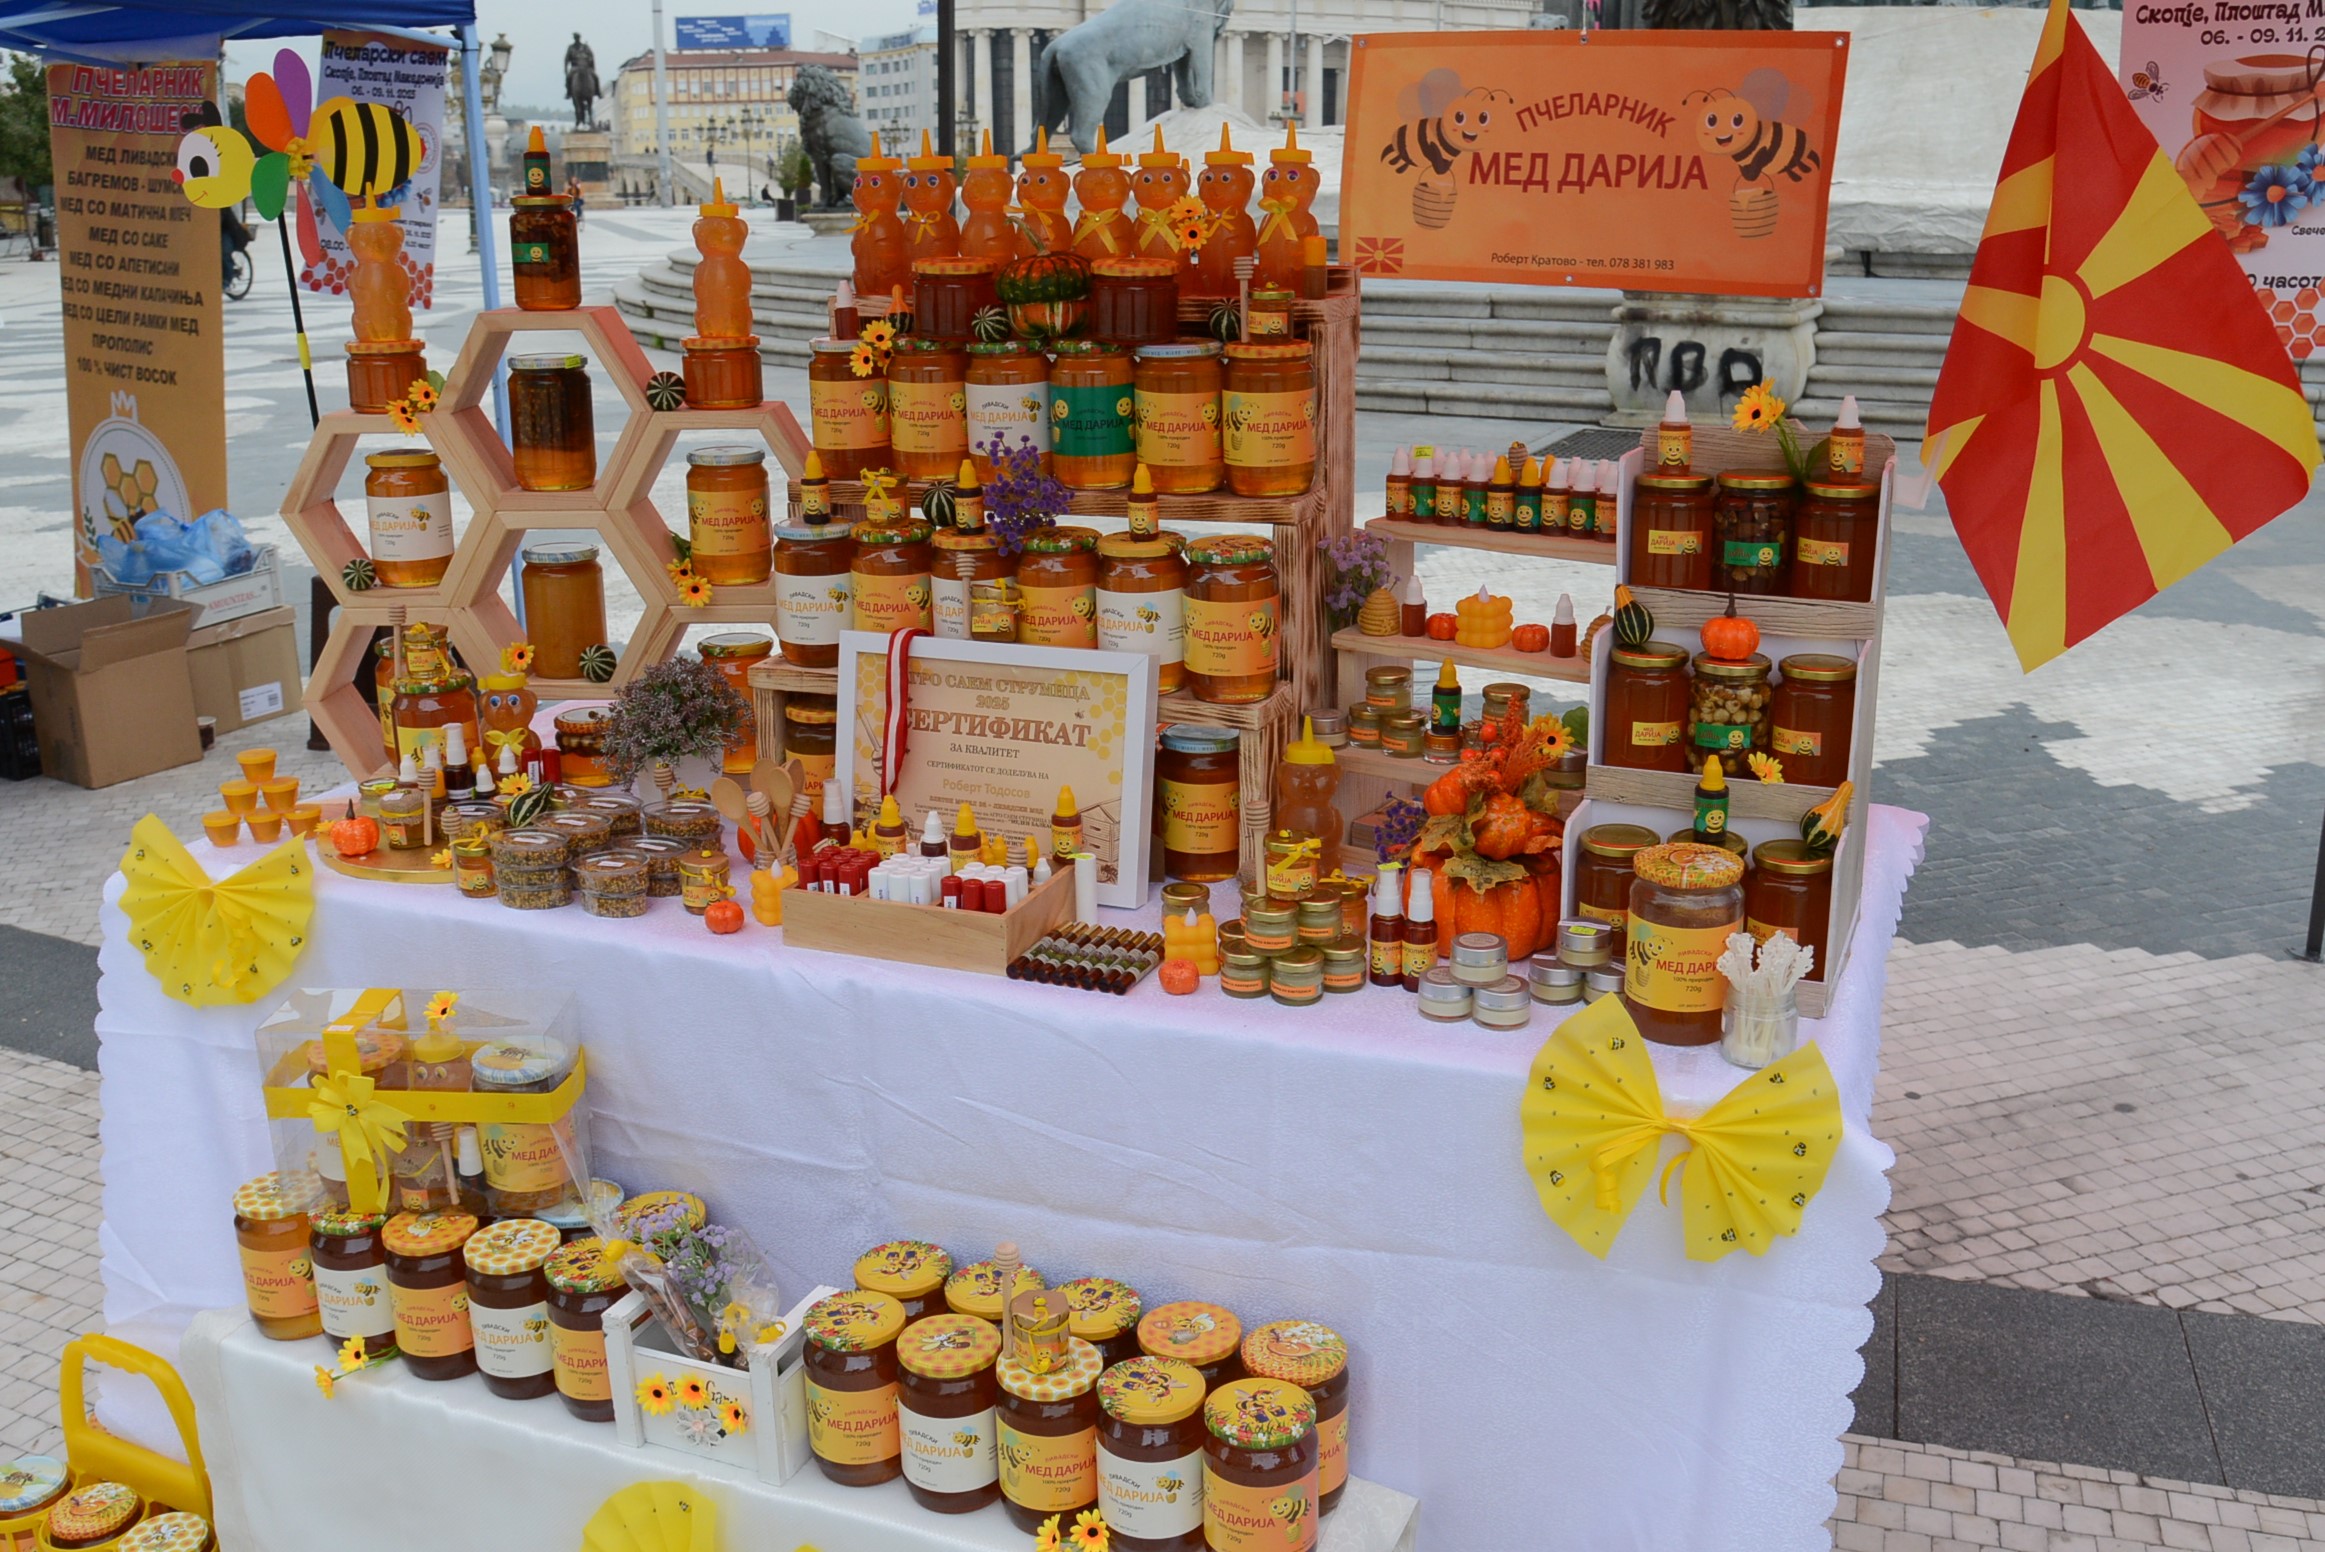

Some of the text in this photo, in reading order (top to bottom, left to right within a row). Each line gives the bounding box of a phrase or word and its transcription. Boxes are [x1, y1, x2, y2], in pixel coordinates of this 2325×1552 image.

[2136, 2, 2300, 26] Скопје, Плоштад
[2201, 30, 2230, 45] 06.
[2251, 28, 2279, 43] 09.
[2286, 28, 2308, 42] 11.
[324, 41, 447, 66] Пчеларски саем
[71, 64, 204, 98] ПЧЕЛАРНИК
[1516, 92, 1676, 139] ПЧЕЛАРНИК
[86, 145, 116, 164] МЕД
[1469, 151, 1708, 194] МЕД ДАРИЈА
[68, 171, 139, 192] БАГРЕМОВ
[60, 197, 166, 222] МЕД СО МАТИЧНА
[89, 226, 169, 249] МЕД СО САКЕ
[69, 251, 92, 269] МЕД
[96, 254, 115, 269] СО
[1491, 253, 1529, 266] Роберт
[1532, 255, 1576, 268] Кратово
[1587, 259, 1607, 268] тел.
[1610, 258, 1629, 268] 078
[1632, 258, 1650, 269] 381
[1655, 260, 1674, 270] 983
[76, 279, 90, 293] СО
[93, 280, 138, 300] МЕДНИ
[2263, 276, 2322, 288] часот
[80, 305, 93, 320] СО
[96, 307, 131, 326] ЦЕЛИ
[133, 313, 167, 330] РАМКИ
[170, 317, 199, 336] МЕД
[92, 333, 154, 355] ПРОПОЛИС
[104, 361, 134, 379] ЧИСТ
[136, 367, 177, 385] ВОСОК
[815, 408, 867, 419] МЕД ДАРИЈА
[898, 410, 955, 421] МЕД ДАРИЈА
[970, 411, 1028, 424] МЕД ДАРИЈА
[1084, 417, 1124, 430] ДАРИЈА
[1146, 422, 1206, 433] МЕД ДАРИЈА
[1246, 421, 1308, 434] МЕД ДАРИЈА
[380, 521, 418, 532] ДАРИЈА
[702, 516, 756, 527] МЕД ДАРИЈА
[778, 600, 835, 613] МЕД ДАРИЈА
[855, 602, 911, 613] МЕД ДАРИЈА
[1018, 613, 1077, 627] МЕД ДАРИЈА
[1106, 619, 1144, 632] ДАРИЈА
[1191, 630, 1254, 643] МЕД ДАРИЈА
[1212, 652, 1226, 660] 720g
[945, 674, 993, 691] САЕМ
[996, 679, 1091, 702] СТРУМИЦА
[975, 695, 1010, 710] 2025
[950, 743, 1020, 759] ЗА КВАЛИТЕТ
[927, 760, 984, 773] СЕРТИФИКАТОТ
[997, 768, 1037, 779] ДОДЕЛУВА
[1038, 772, 1049, 780] НА
[942, 779, 1030, 799] Роберт Тодосов
[1173, 809, 1233, 823] МЕД ДАРИЈА
[1656, 959, 1684, 974] МЕД
[1686, 985, 1702, 993] 720g
[512, 1151, 536, 1162] МЕД
[256, 1277, 296, 1287] ДАРИЈА
[324, 1294, 364, 1306] ДАРИЈА
[396, 1312, 458, 1326] МЕД ДАРИЈА
[473, 1330, 533, 1345] МЕД ДАРИЈА
[557, 1352, 575, 1367] МЕД
[827, 1412, 899, 1433] МЕД ДАРИЈА
[901, 1431, 962, 1458] МЕД ДАРИЈА
[1025, 1456, 1097, 1478] МЕД ДАРИЈА
[1099, 1472, 1164, 1503] МЕД ДАРИЈА
[1117, 1507, 1132, 1518] 720g
[1207, 1499, 1275, 1528] МЕД ДАРИЈА
[1226, 1532, 1242, 1544] 720g
